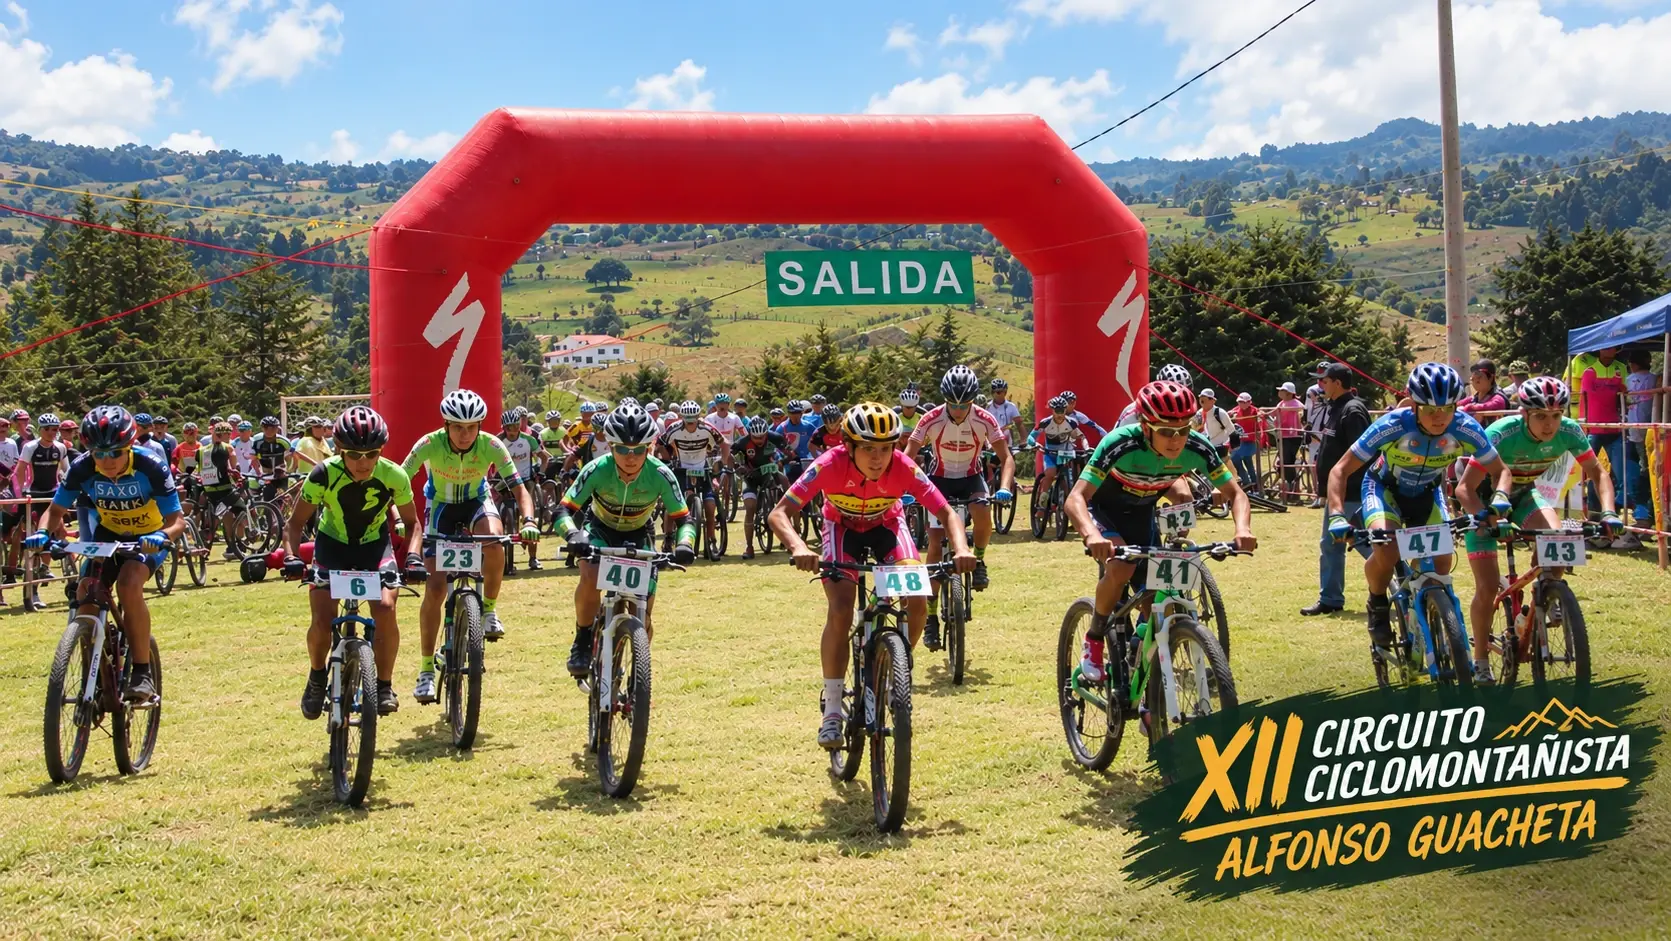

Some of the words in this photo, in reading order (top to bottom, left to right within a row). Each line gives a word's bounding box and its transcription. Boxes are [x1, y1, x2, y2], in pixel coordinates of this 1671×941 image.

[778, 261, 963, 295] SALIDA
[97, 484, 138, 496] SAXO
[1166, 510, 1192, 530] 42
[1408, 531, 1441, 553] 47
[1543, 541, 1577, 563] 43
[442, 549, 473, 568] 23
[606, 565, 641, 589] 40
[886, 572, 923, 592] 48
[1156, 559, 1190, 584] 41
[350, 577, 367, 597] 6
